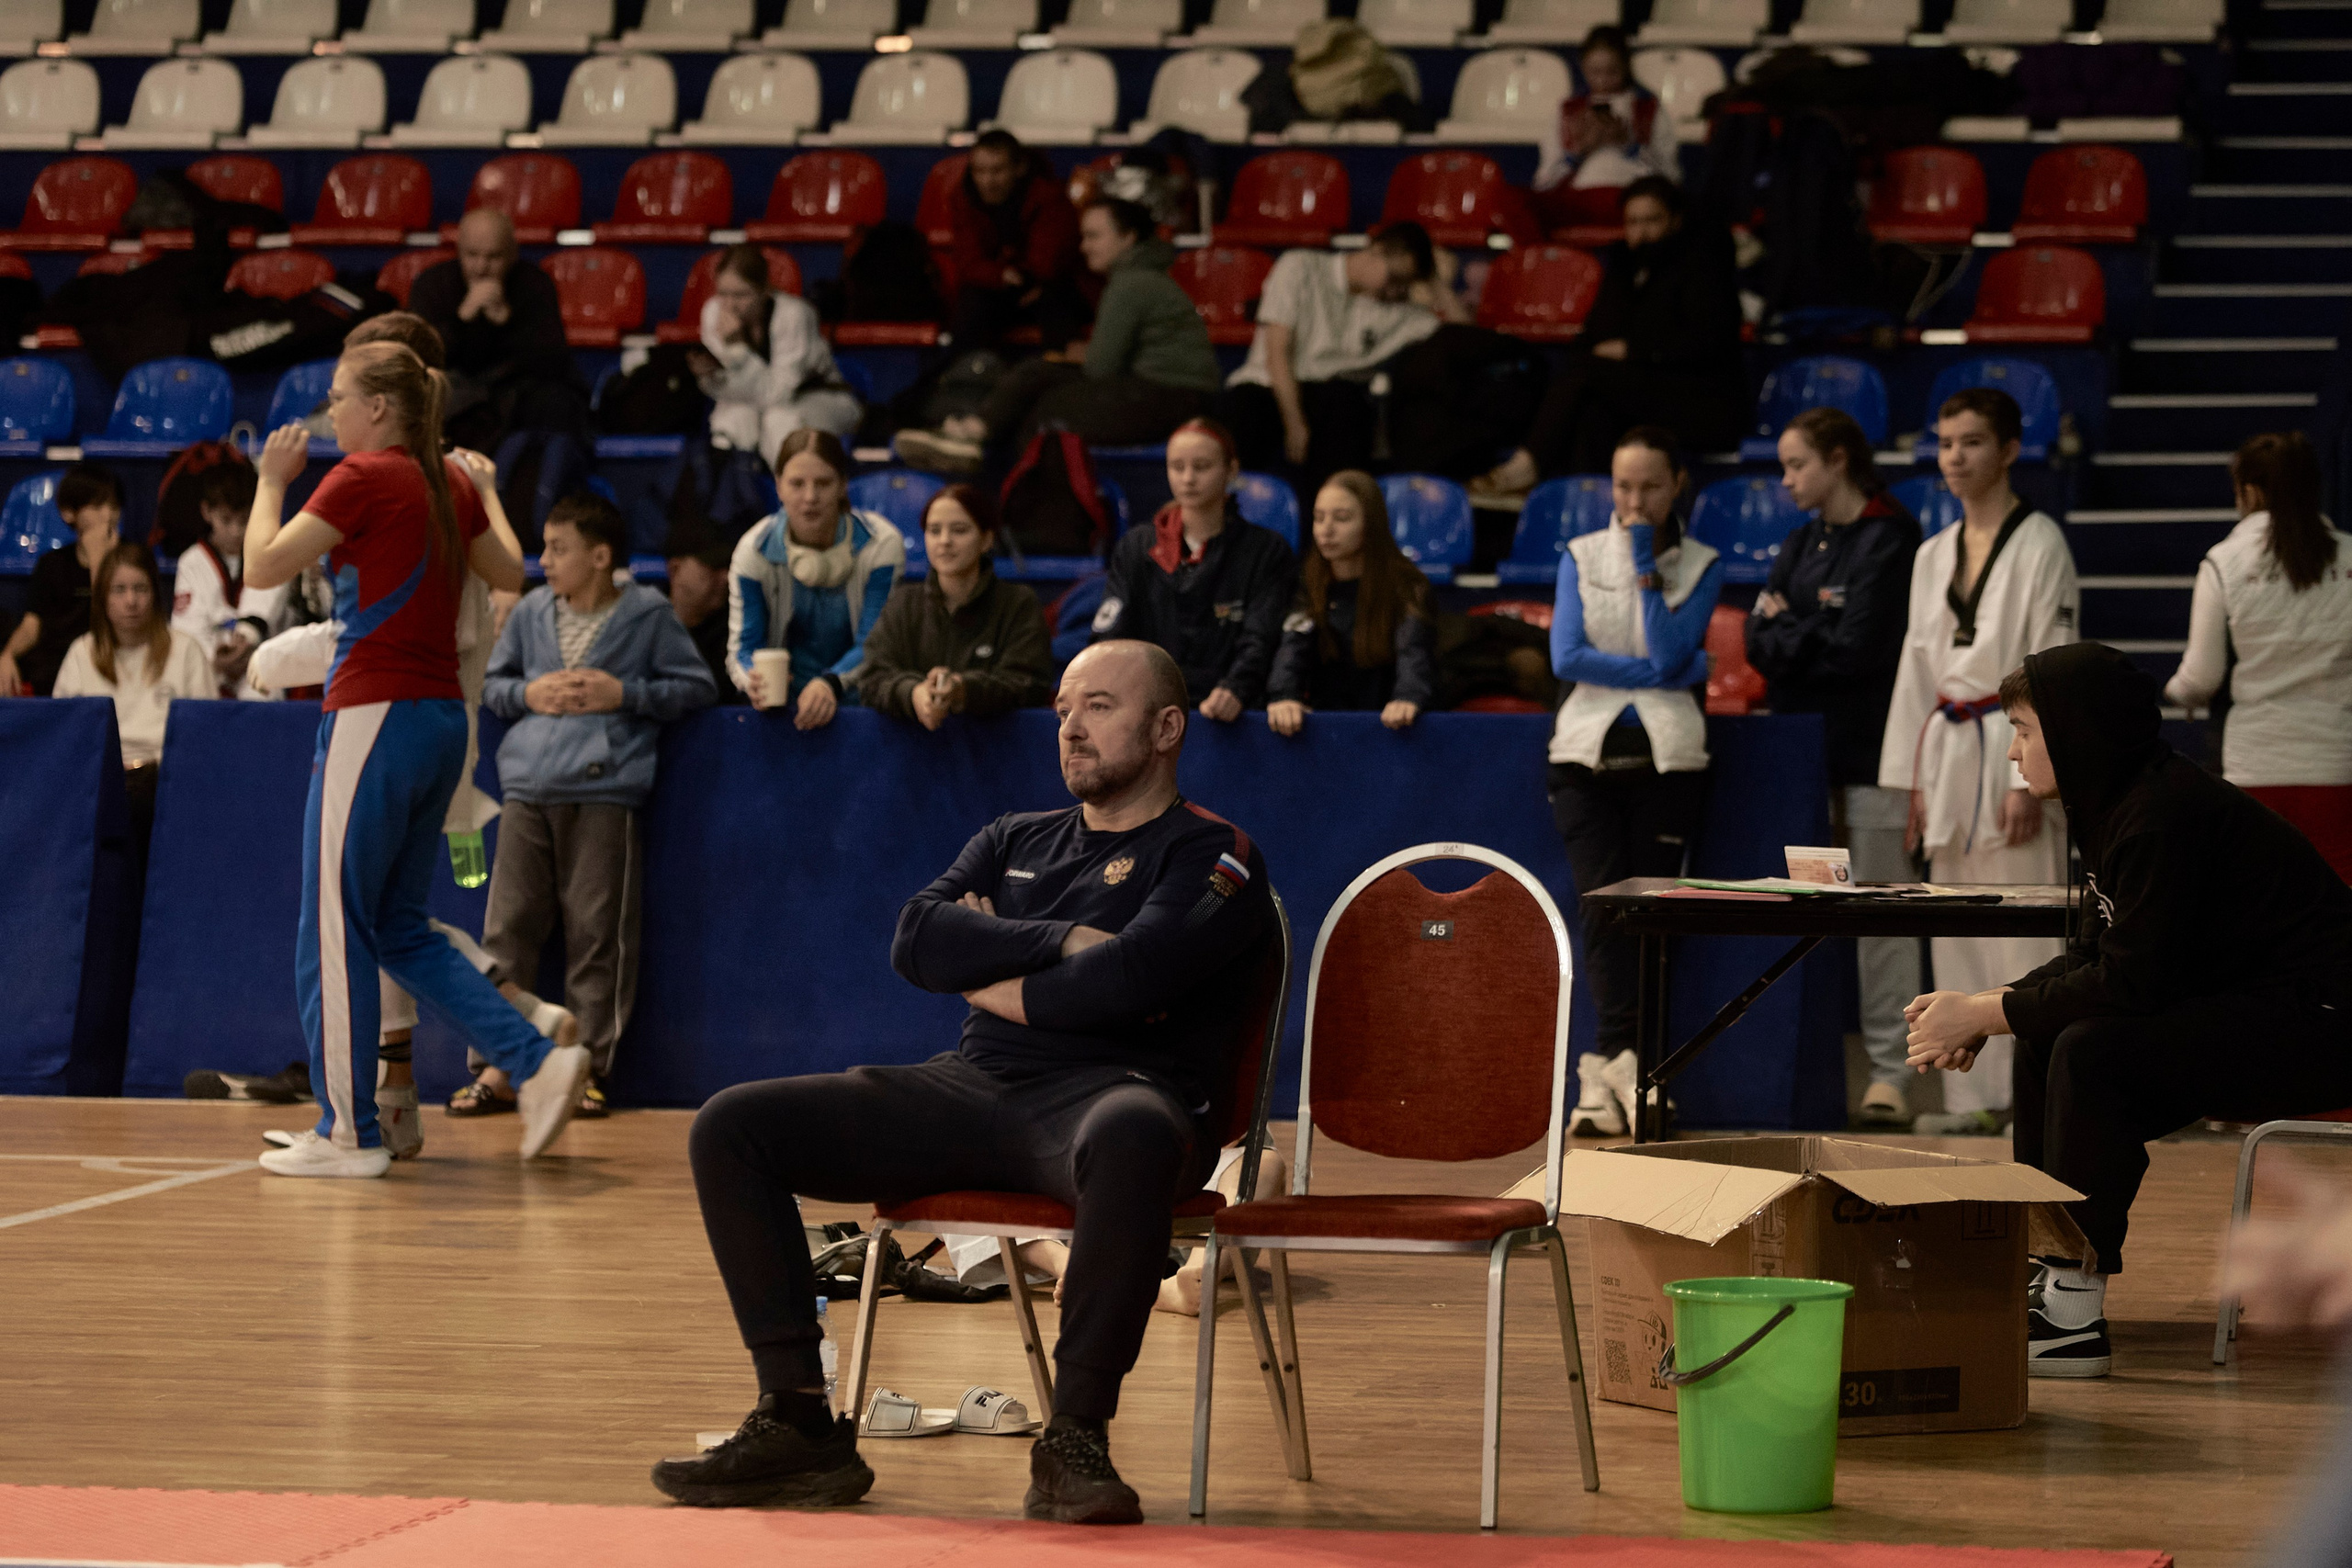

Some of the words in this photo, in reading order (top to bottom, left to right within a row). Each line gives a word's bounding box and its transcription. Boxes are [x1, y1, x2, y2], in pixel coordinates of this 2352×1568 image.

[1004, 867, 1035, 879] FORWARD
[1429, 924, 1446, 936] 45
[1844, 1381, 1876, 1406] 30
